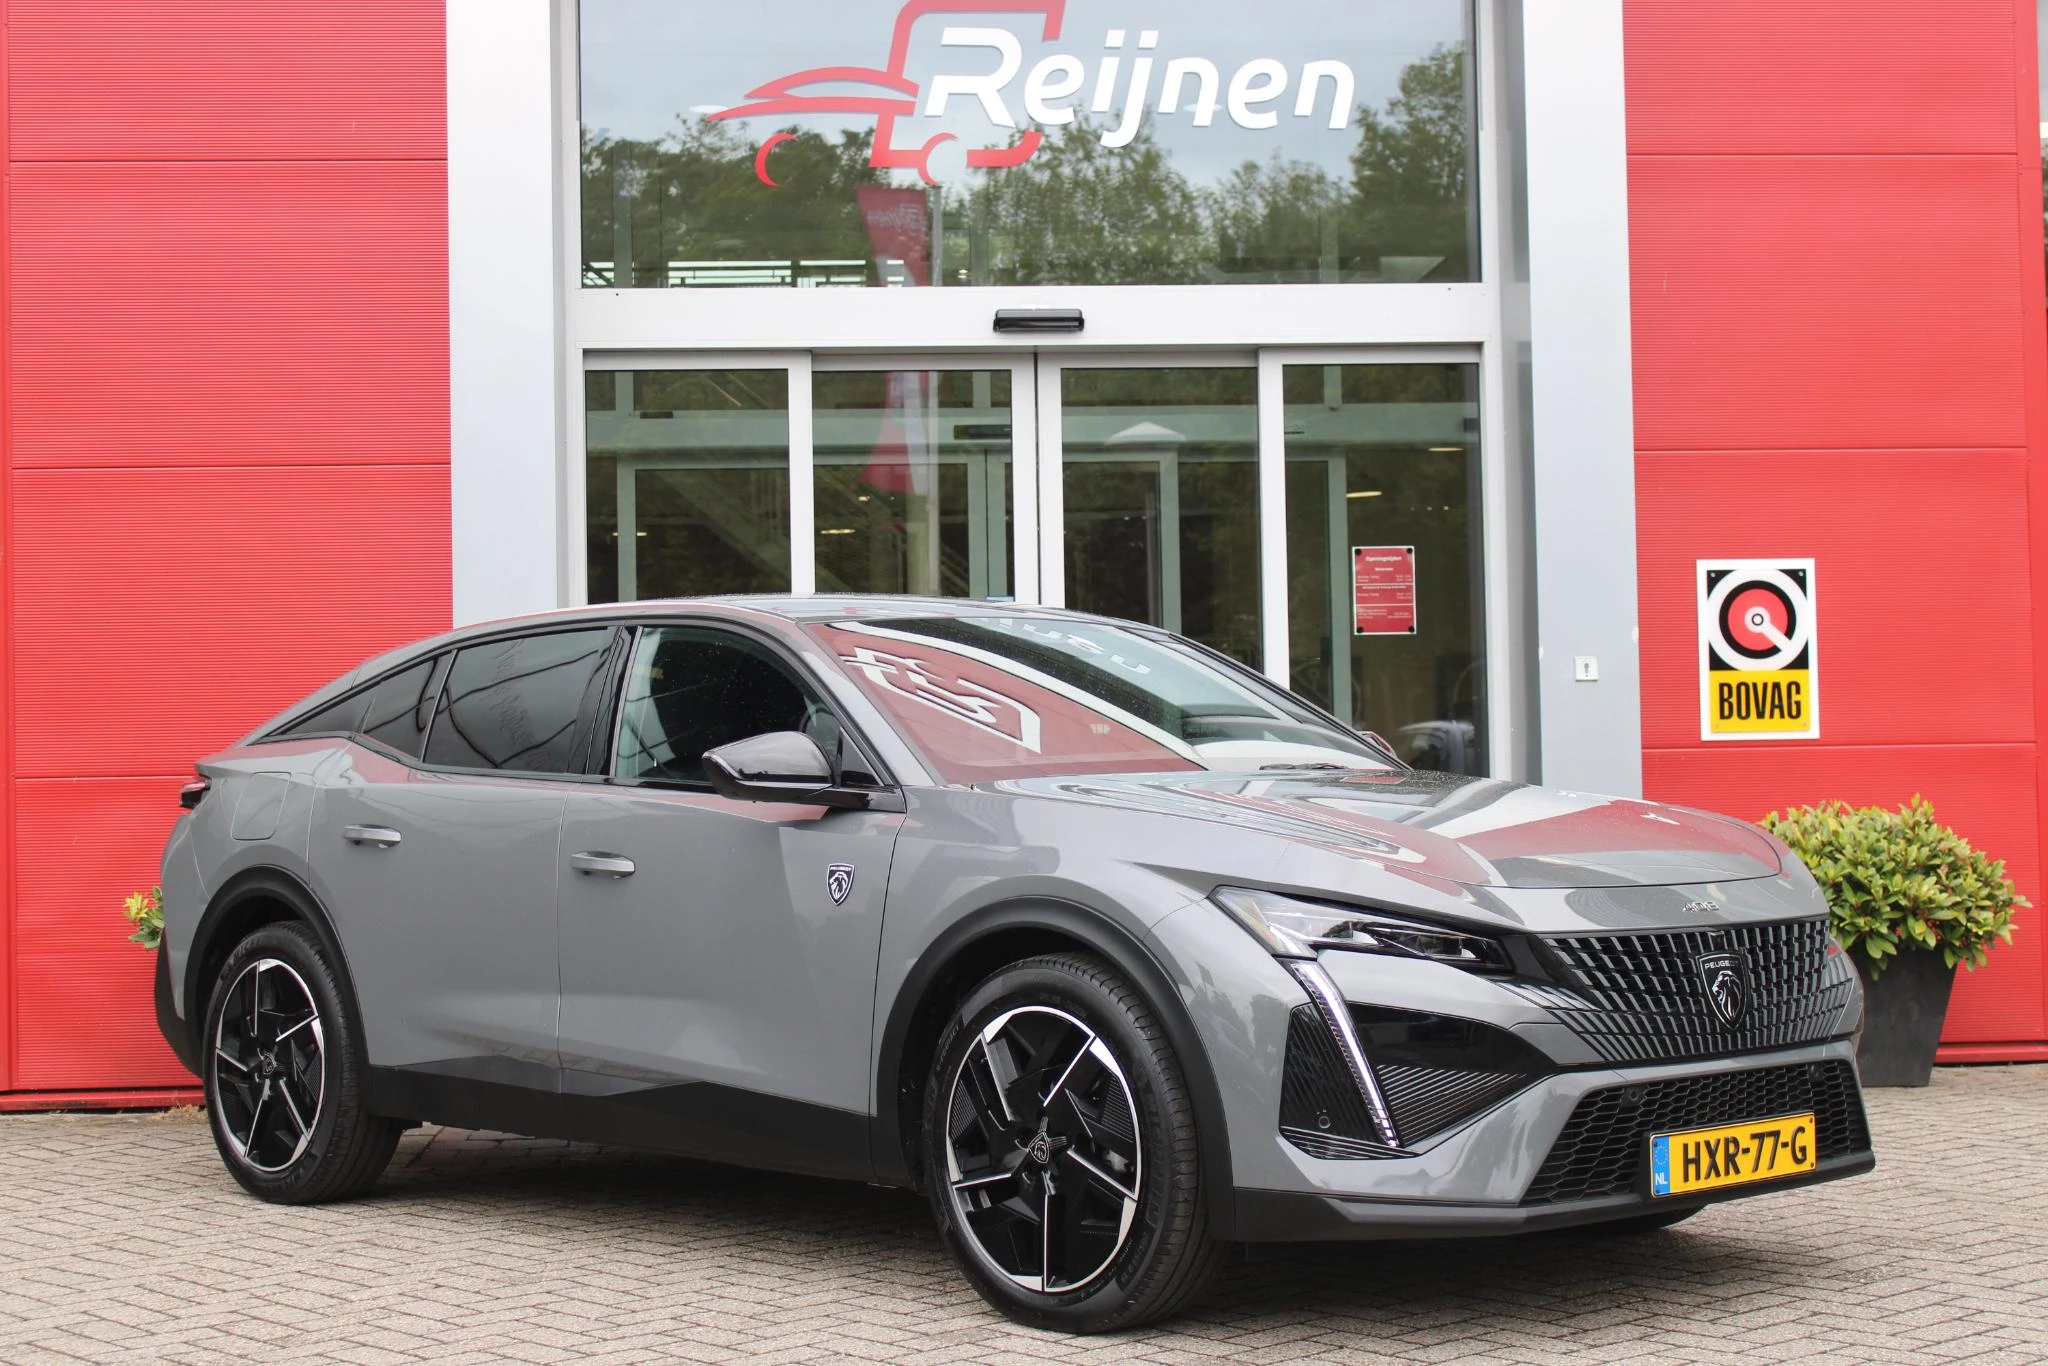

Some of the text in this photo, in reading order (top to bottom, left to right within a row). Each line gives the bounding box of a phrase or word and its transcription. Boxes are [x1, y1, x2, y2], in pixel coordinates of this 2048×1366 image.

[925, 27, 1355, 148] Reijnen
[1718, 681, 1802, 720] BOVAG
[1682, 901, 1720, 912] 408
[1704, 960, 1738, 969] PEUGEOT
[1682, 1126, 1808, 1183] HXR-77-G
[1655, 1172, 1668, 1185] NL
